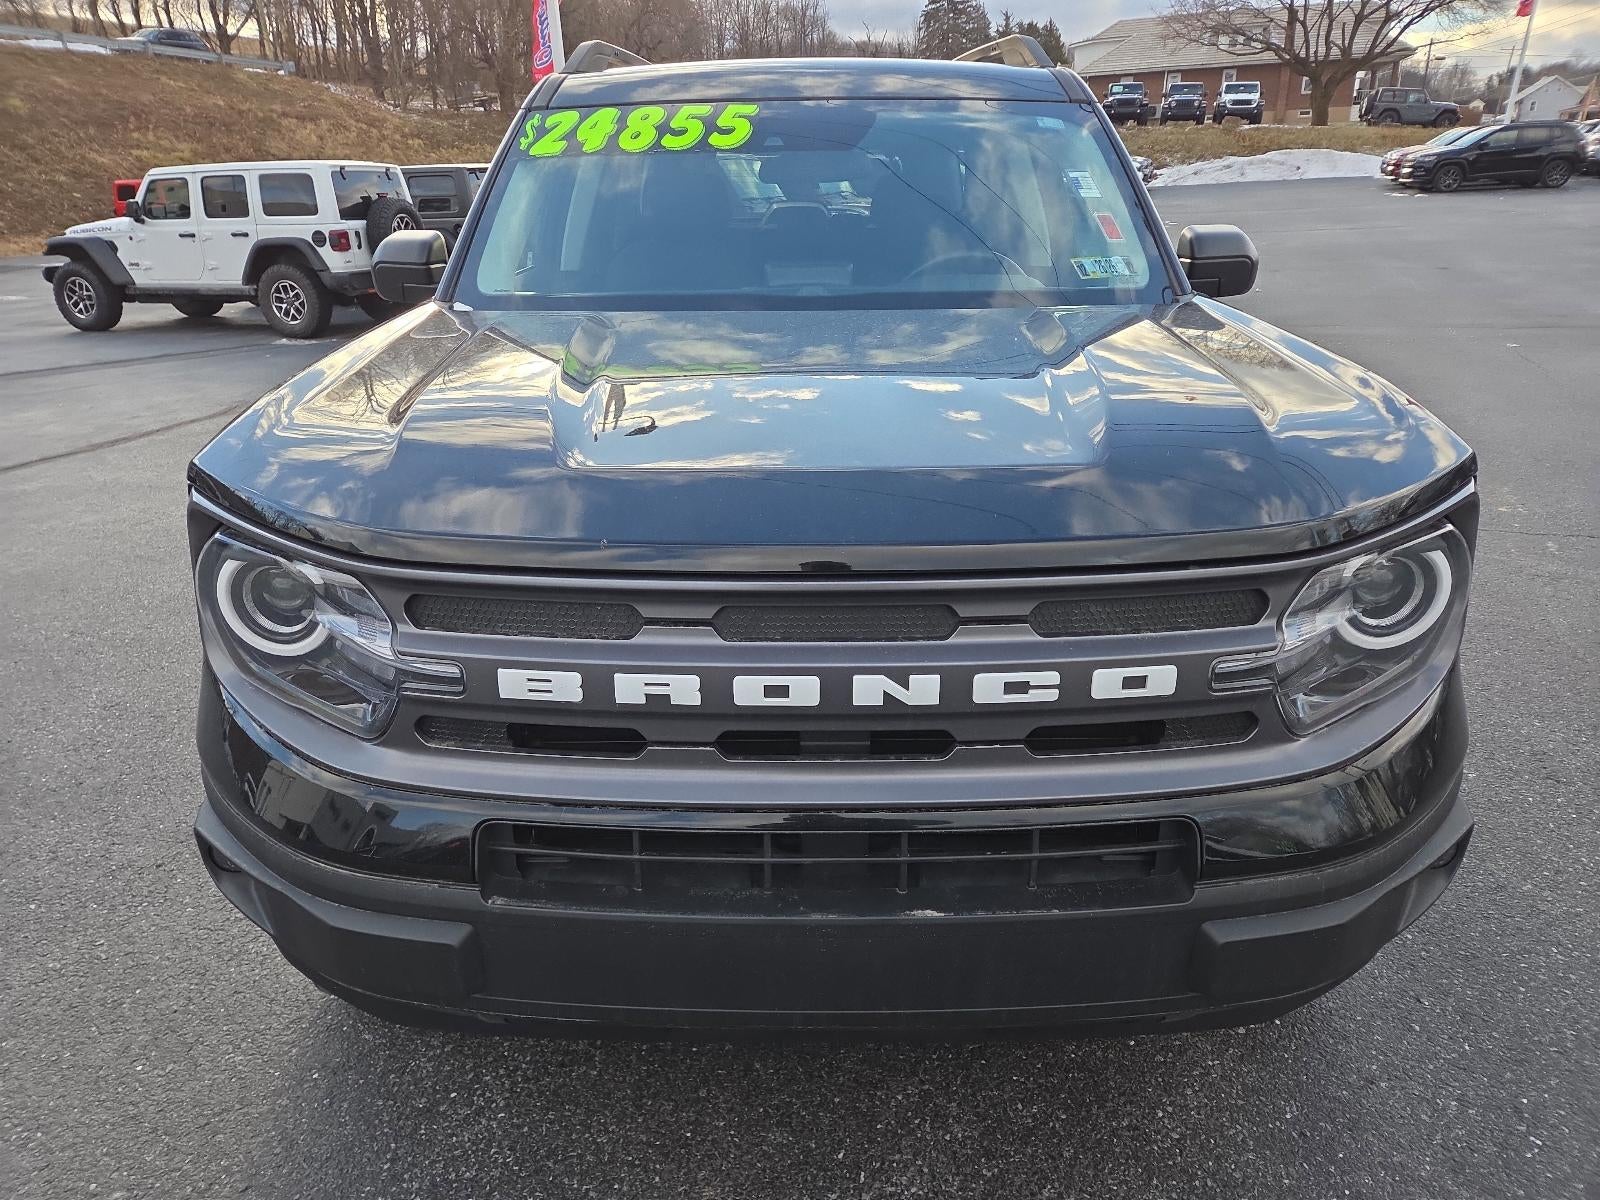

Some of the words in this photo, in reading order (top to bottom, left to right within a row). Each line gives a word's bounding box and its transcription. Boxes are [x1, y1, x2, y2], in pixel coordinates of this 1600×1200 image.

[520, 104, 760, 158] $24855
[69, 226, 112, 235] RUBICON
[497, 664, 1179, 706] BRONCO
